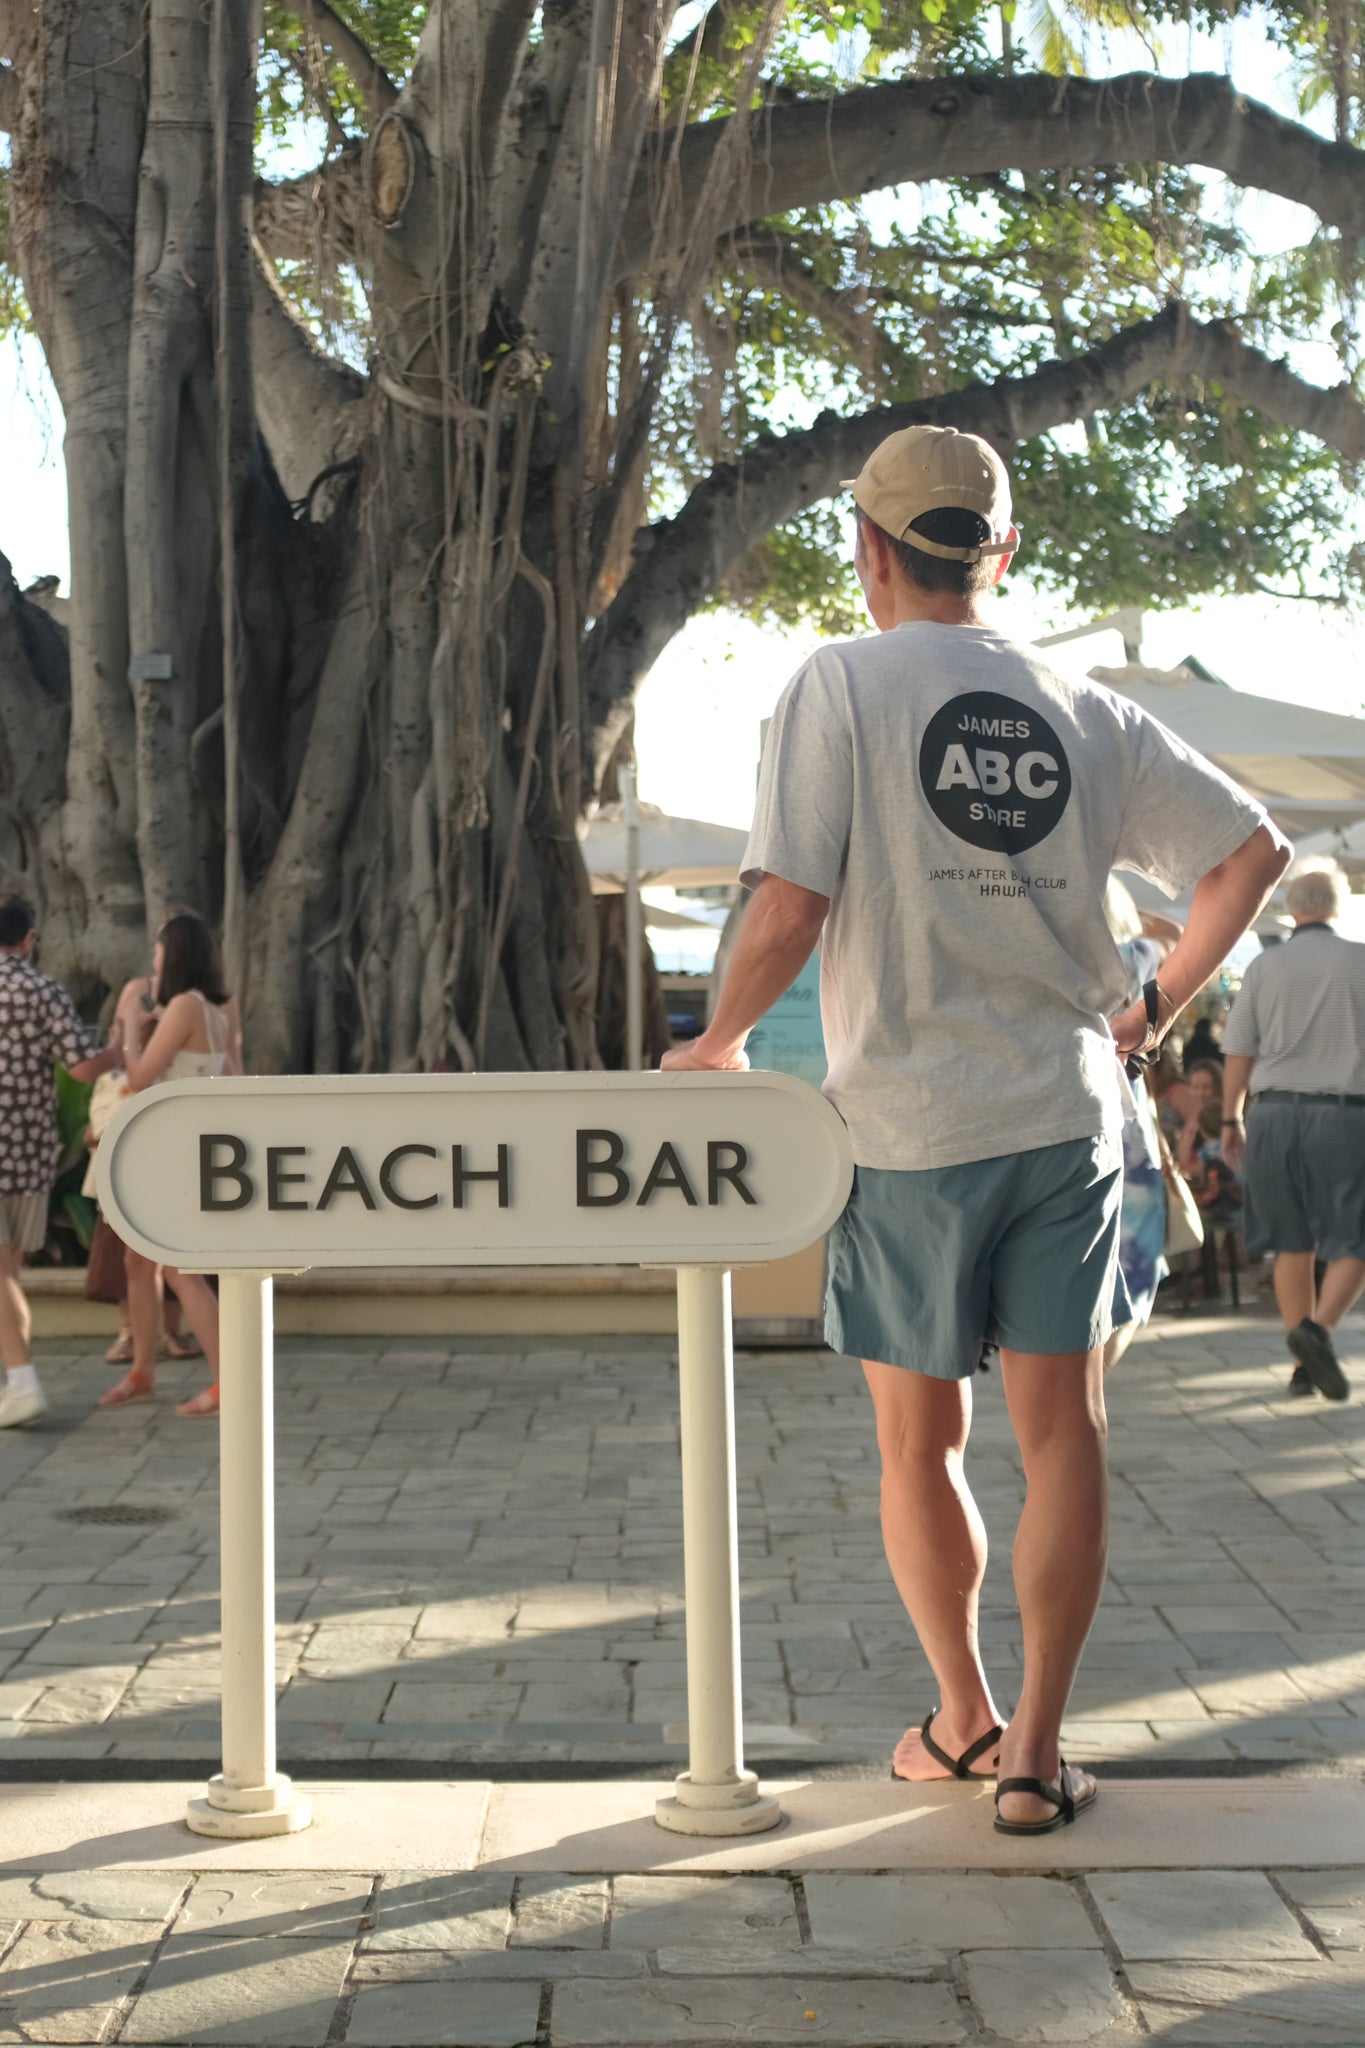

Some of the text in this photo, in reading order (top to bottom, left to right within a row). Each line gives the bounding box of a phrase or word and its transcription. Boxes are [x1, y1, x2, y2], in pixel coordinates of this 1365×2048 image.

[957, 714, 1031, 739] JAMES
[935, 743, 1059, 800] ABC
[929, 869, 965, 881] JAMES
[967, 868, 1007, 881] AFTER
[1034, 877, 1067, 889] CLUB
[980, 884, 1027, 898] HAWA
[198, 1128, 758, 1212] BEACH BAR
